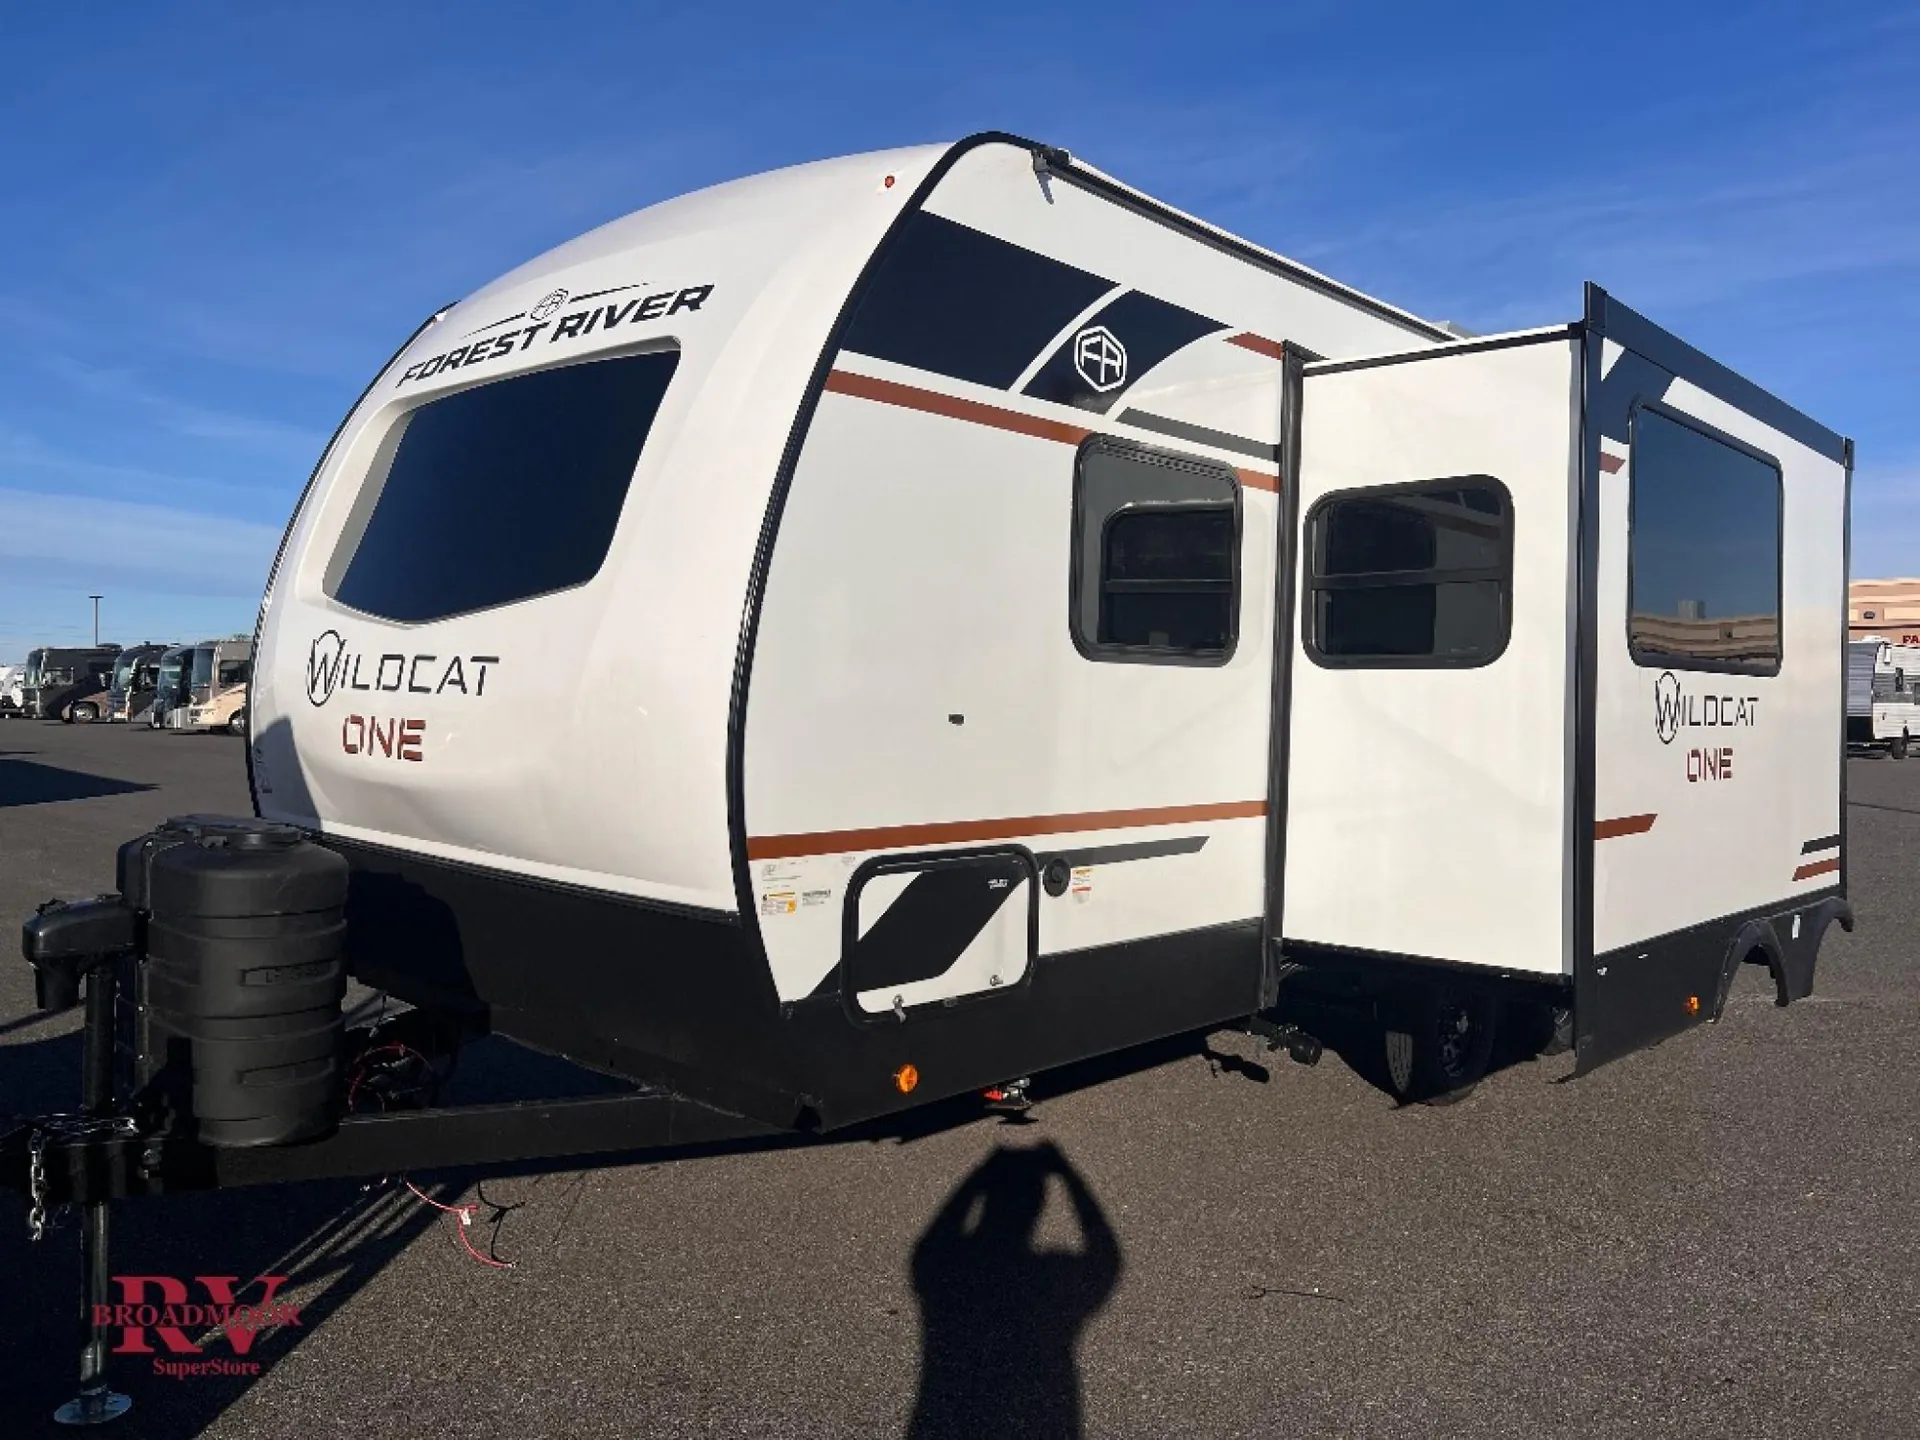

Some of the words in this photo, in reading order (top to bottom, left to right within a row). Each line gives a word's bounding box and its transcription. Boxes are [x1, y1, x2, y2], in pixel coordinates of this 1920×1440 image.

[396, 321, 551, 388] FOREST
[550, 284, 715, 343] RIVER
[306, 630, 500, 707] WILDCAT
[342, 714, 426, 762] ONE
[1655, 671, 1759, 744] WILDCAT
[1687, 748, 1733, 782] ONE
